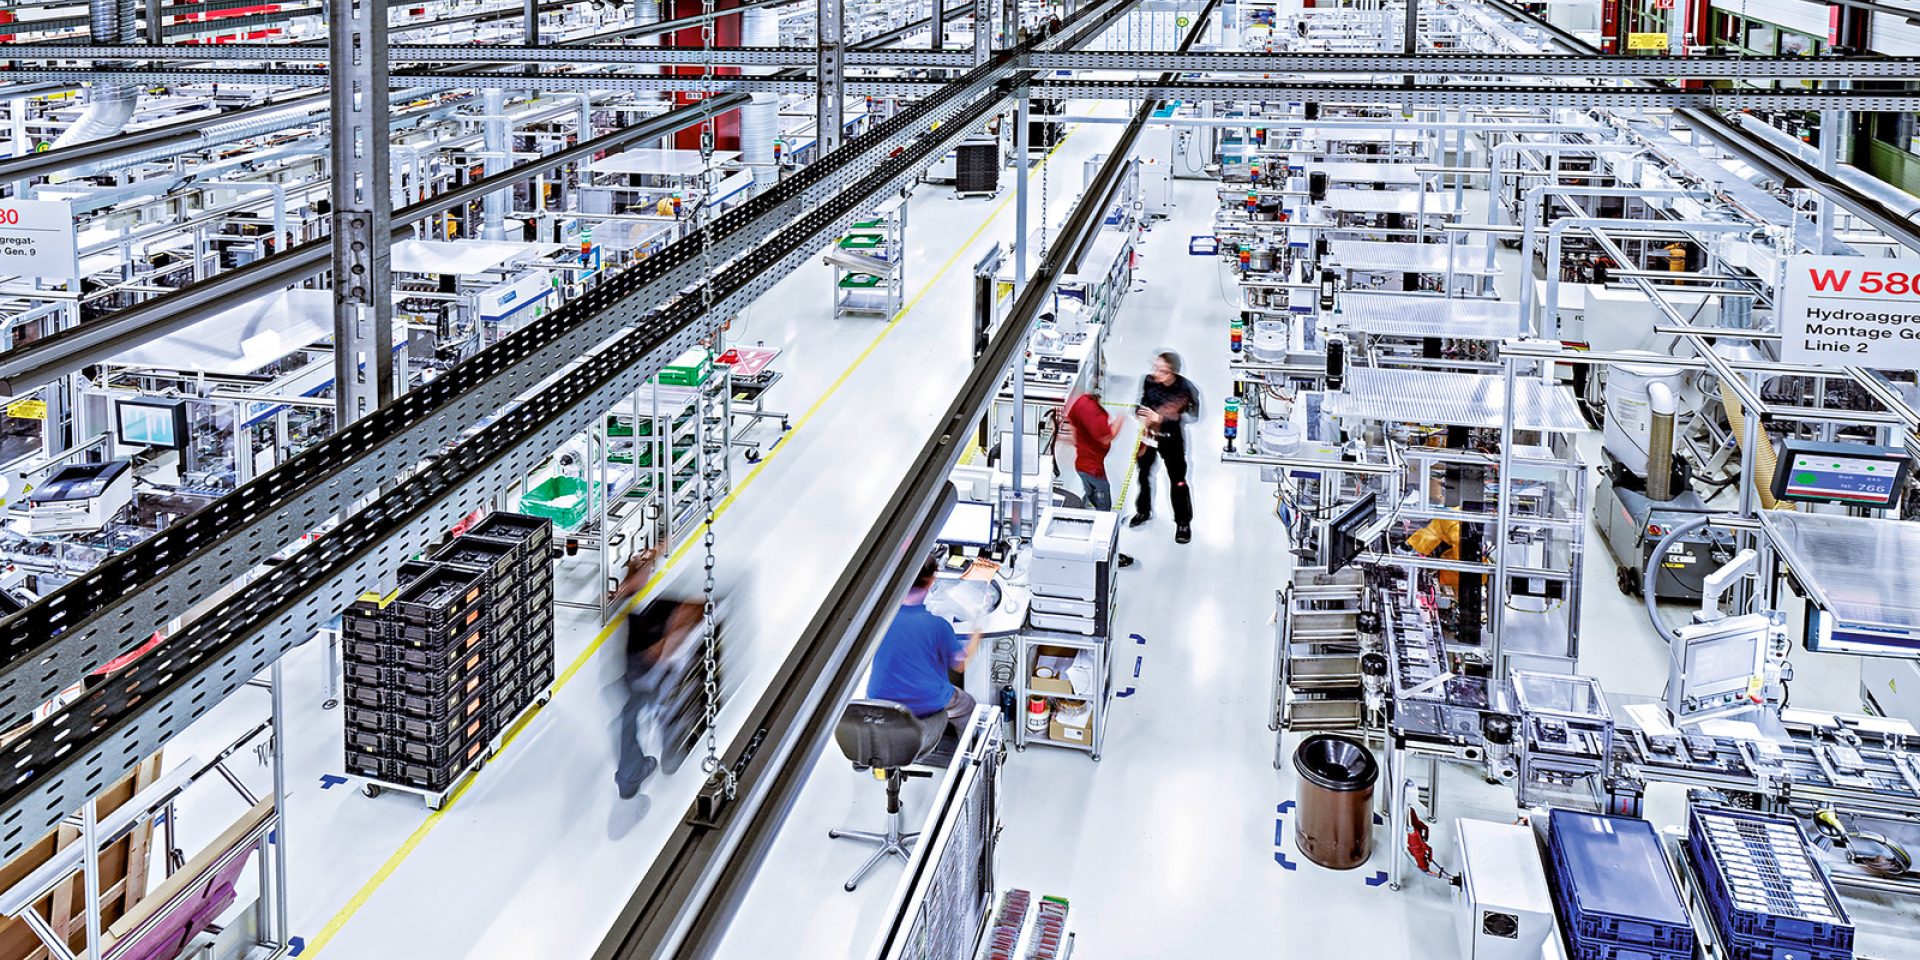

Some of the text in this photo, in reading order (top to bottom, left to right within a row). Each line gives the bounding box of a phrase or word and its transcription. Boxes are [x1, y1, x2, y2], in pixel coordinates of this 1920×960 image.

[4, 246, 37, 256] Gen. 9
[1808, 268, 1852, 292] W
[1806, 307, 1920, 325] Hydroaggre
[1805, 324, 1893, 340] Montage
[1804, 339, 1869, 354] Linie 2
[1857, 483, 1885, 492] 766
